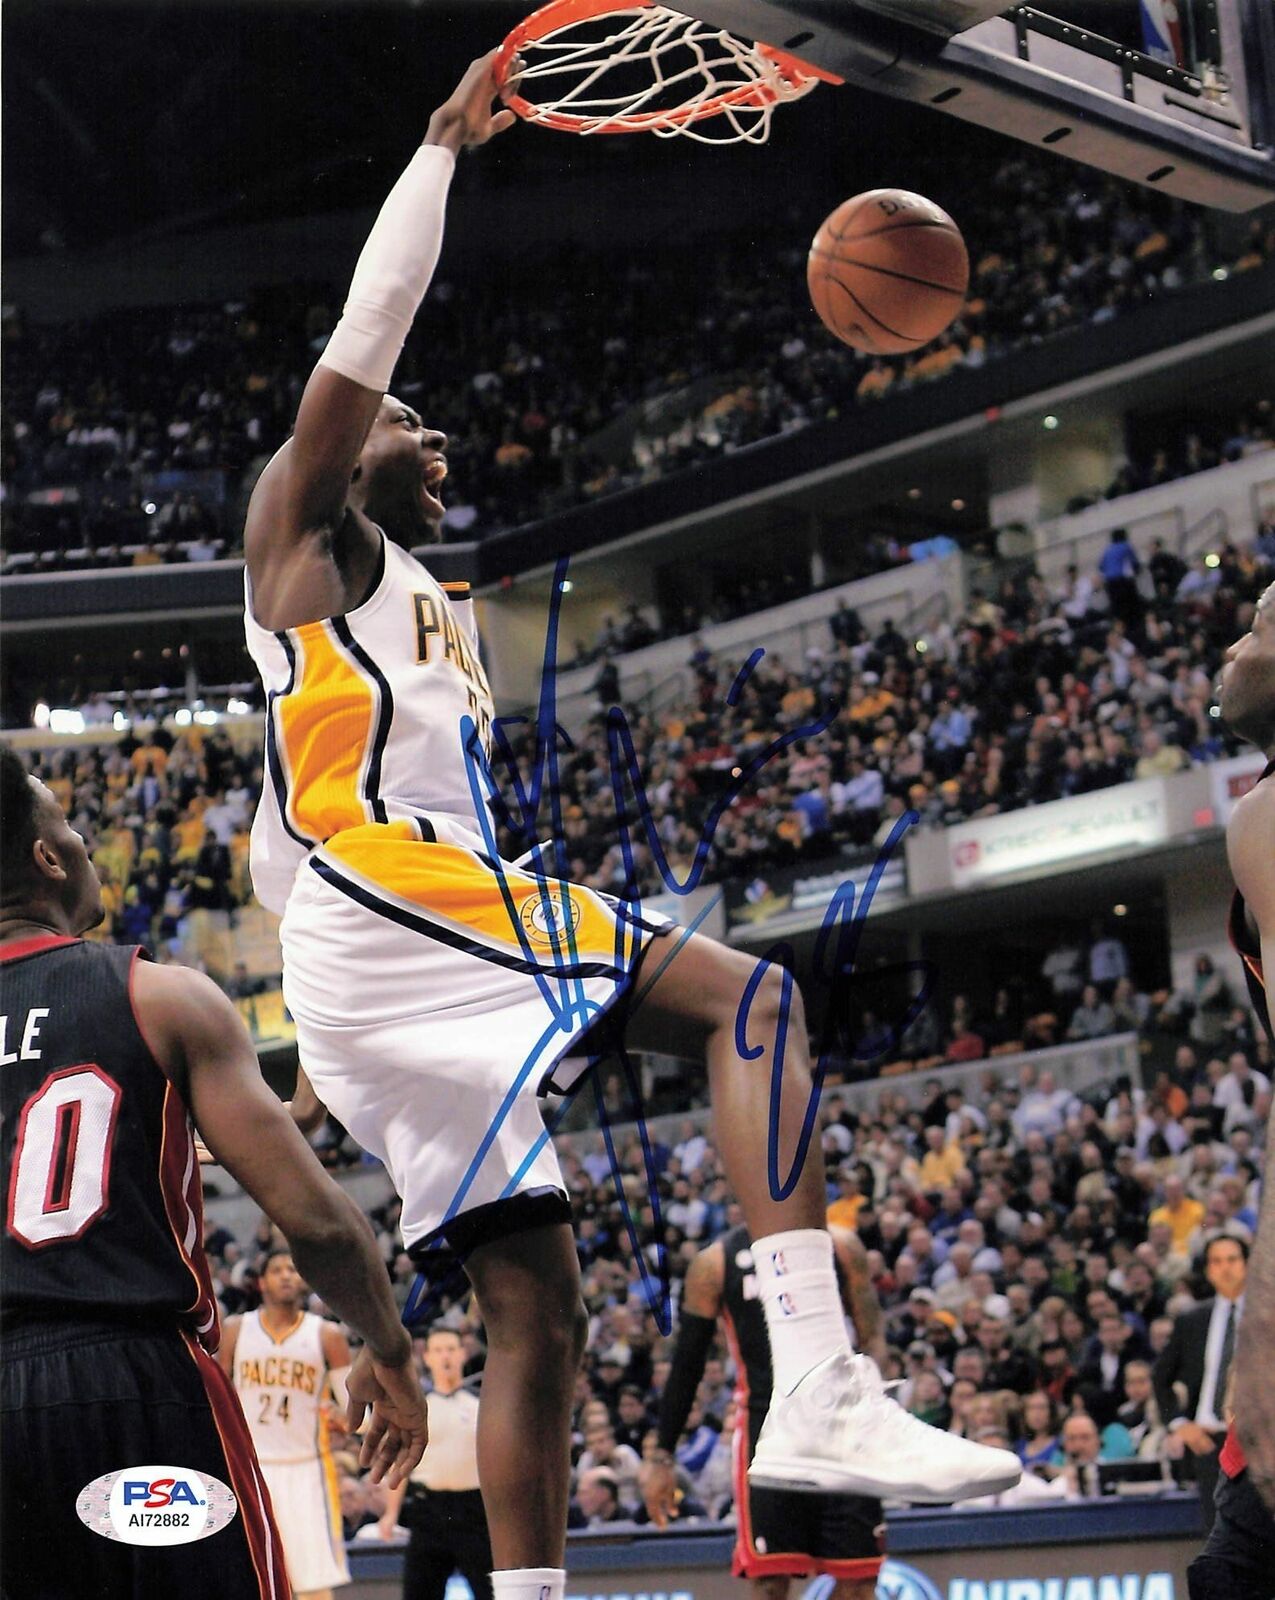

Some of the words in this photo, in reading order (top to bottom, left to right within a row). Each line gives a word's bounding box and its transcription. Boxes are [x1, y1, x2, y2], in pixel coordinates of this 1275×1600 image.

[7, 1063, 122, 1252] 0
[240, 1356, 317, 1395] PACERS
[258, 1393, 290, 1425] 24
